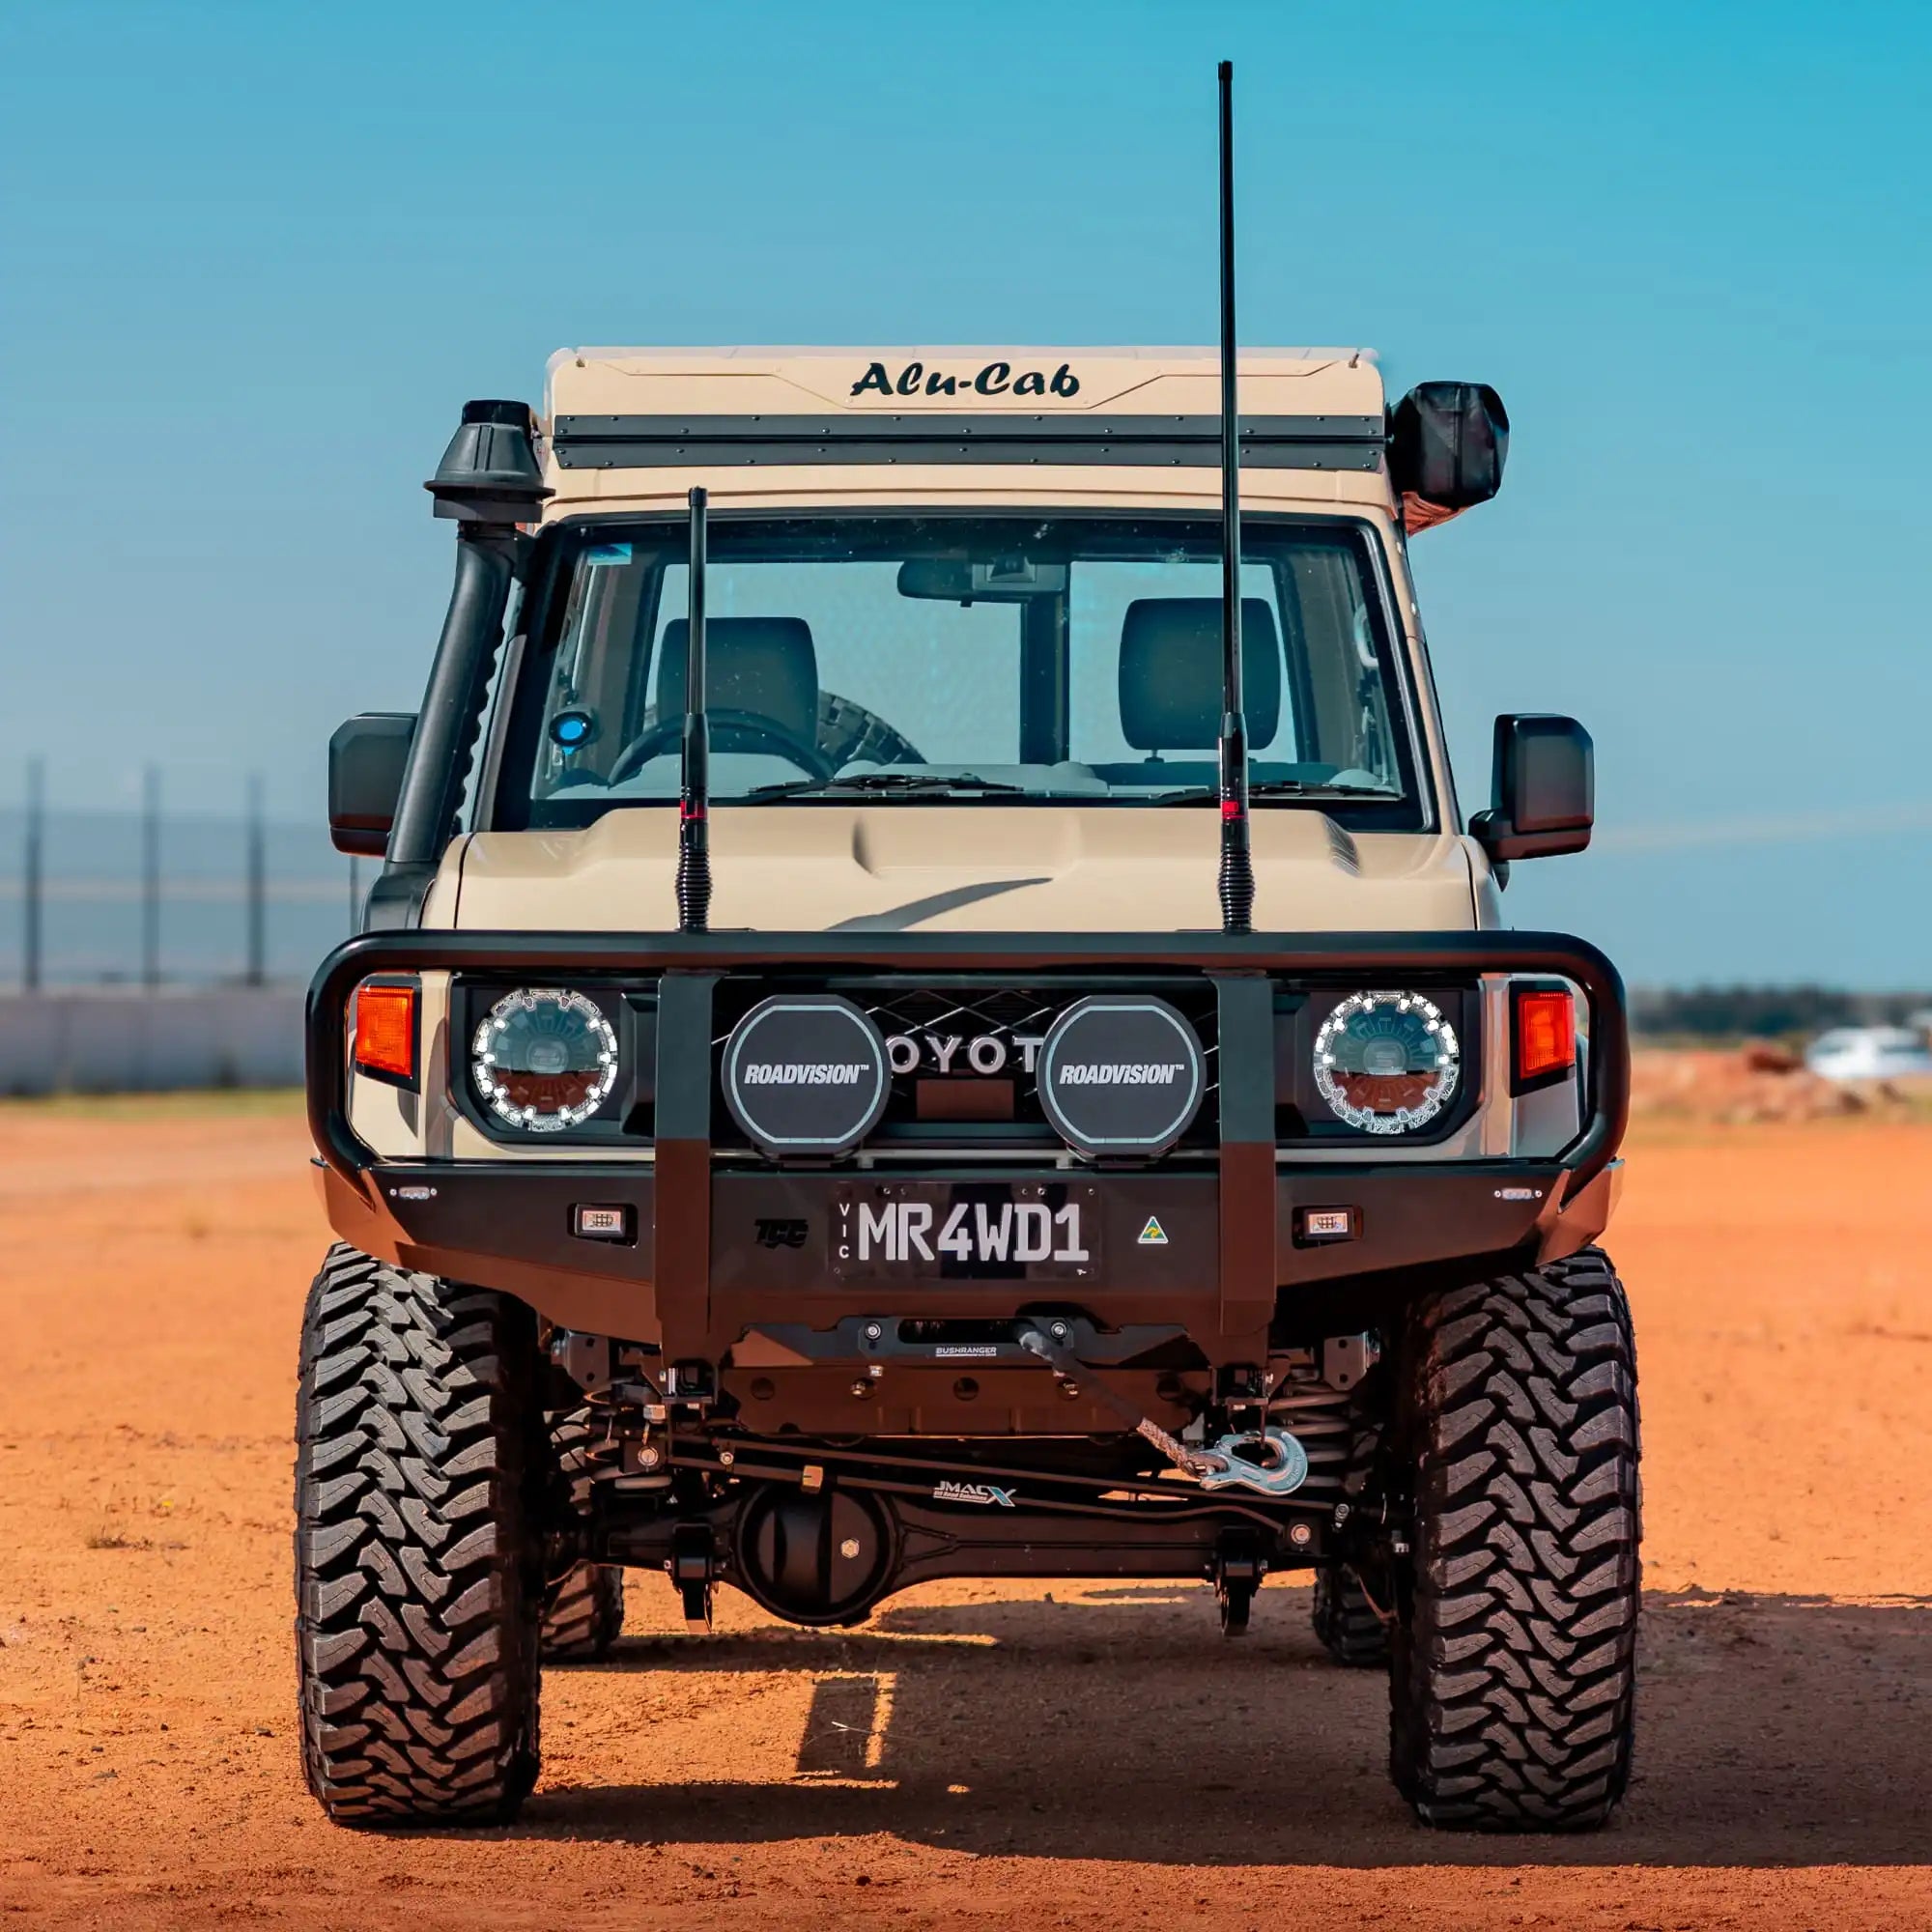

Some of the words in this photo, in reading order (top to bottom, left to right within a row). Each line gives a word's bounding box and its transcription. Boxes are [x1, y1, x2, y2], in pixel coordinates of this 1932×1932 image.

[849, 362, 1080, 397] Alu-Cab
[885, 1035, 1044, 1074] OYOT
[858, 1203, 1090, 1262] MR4WD1
